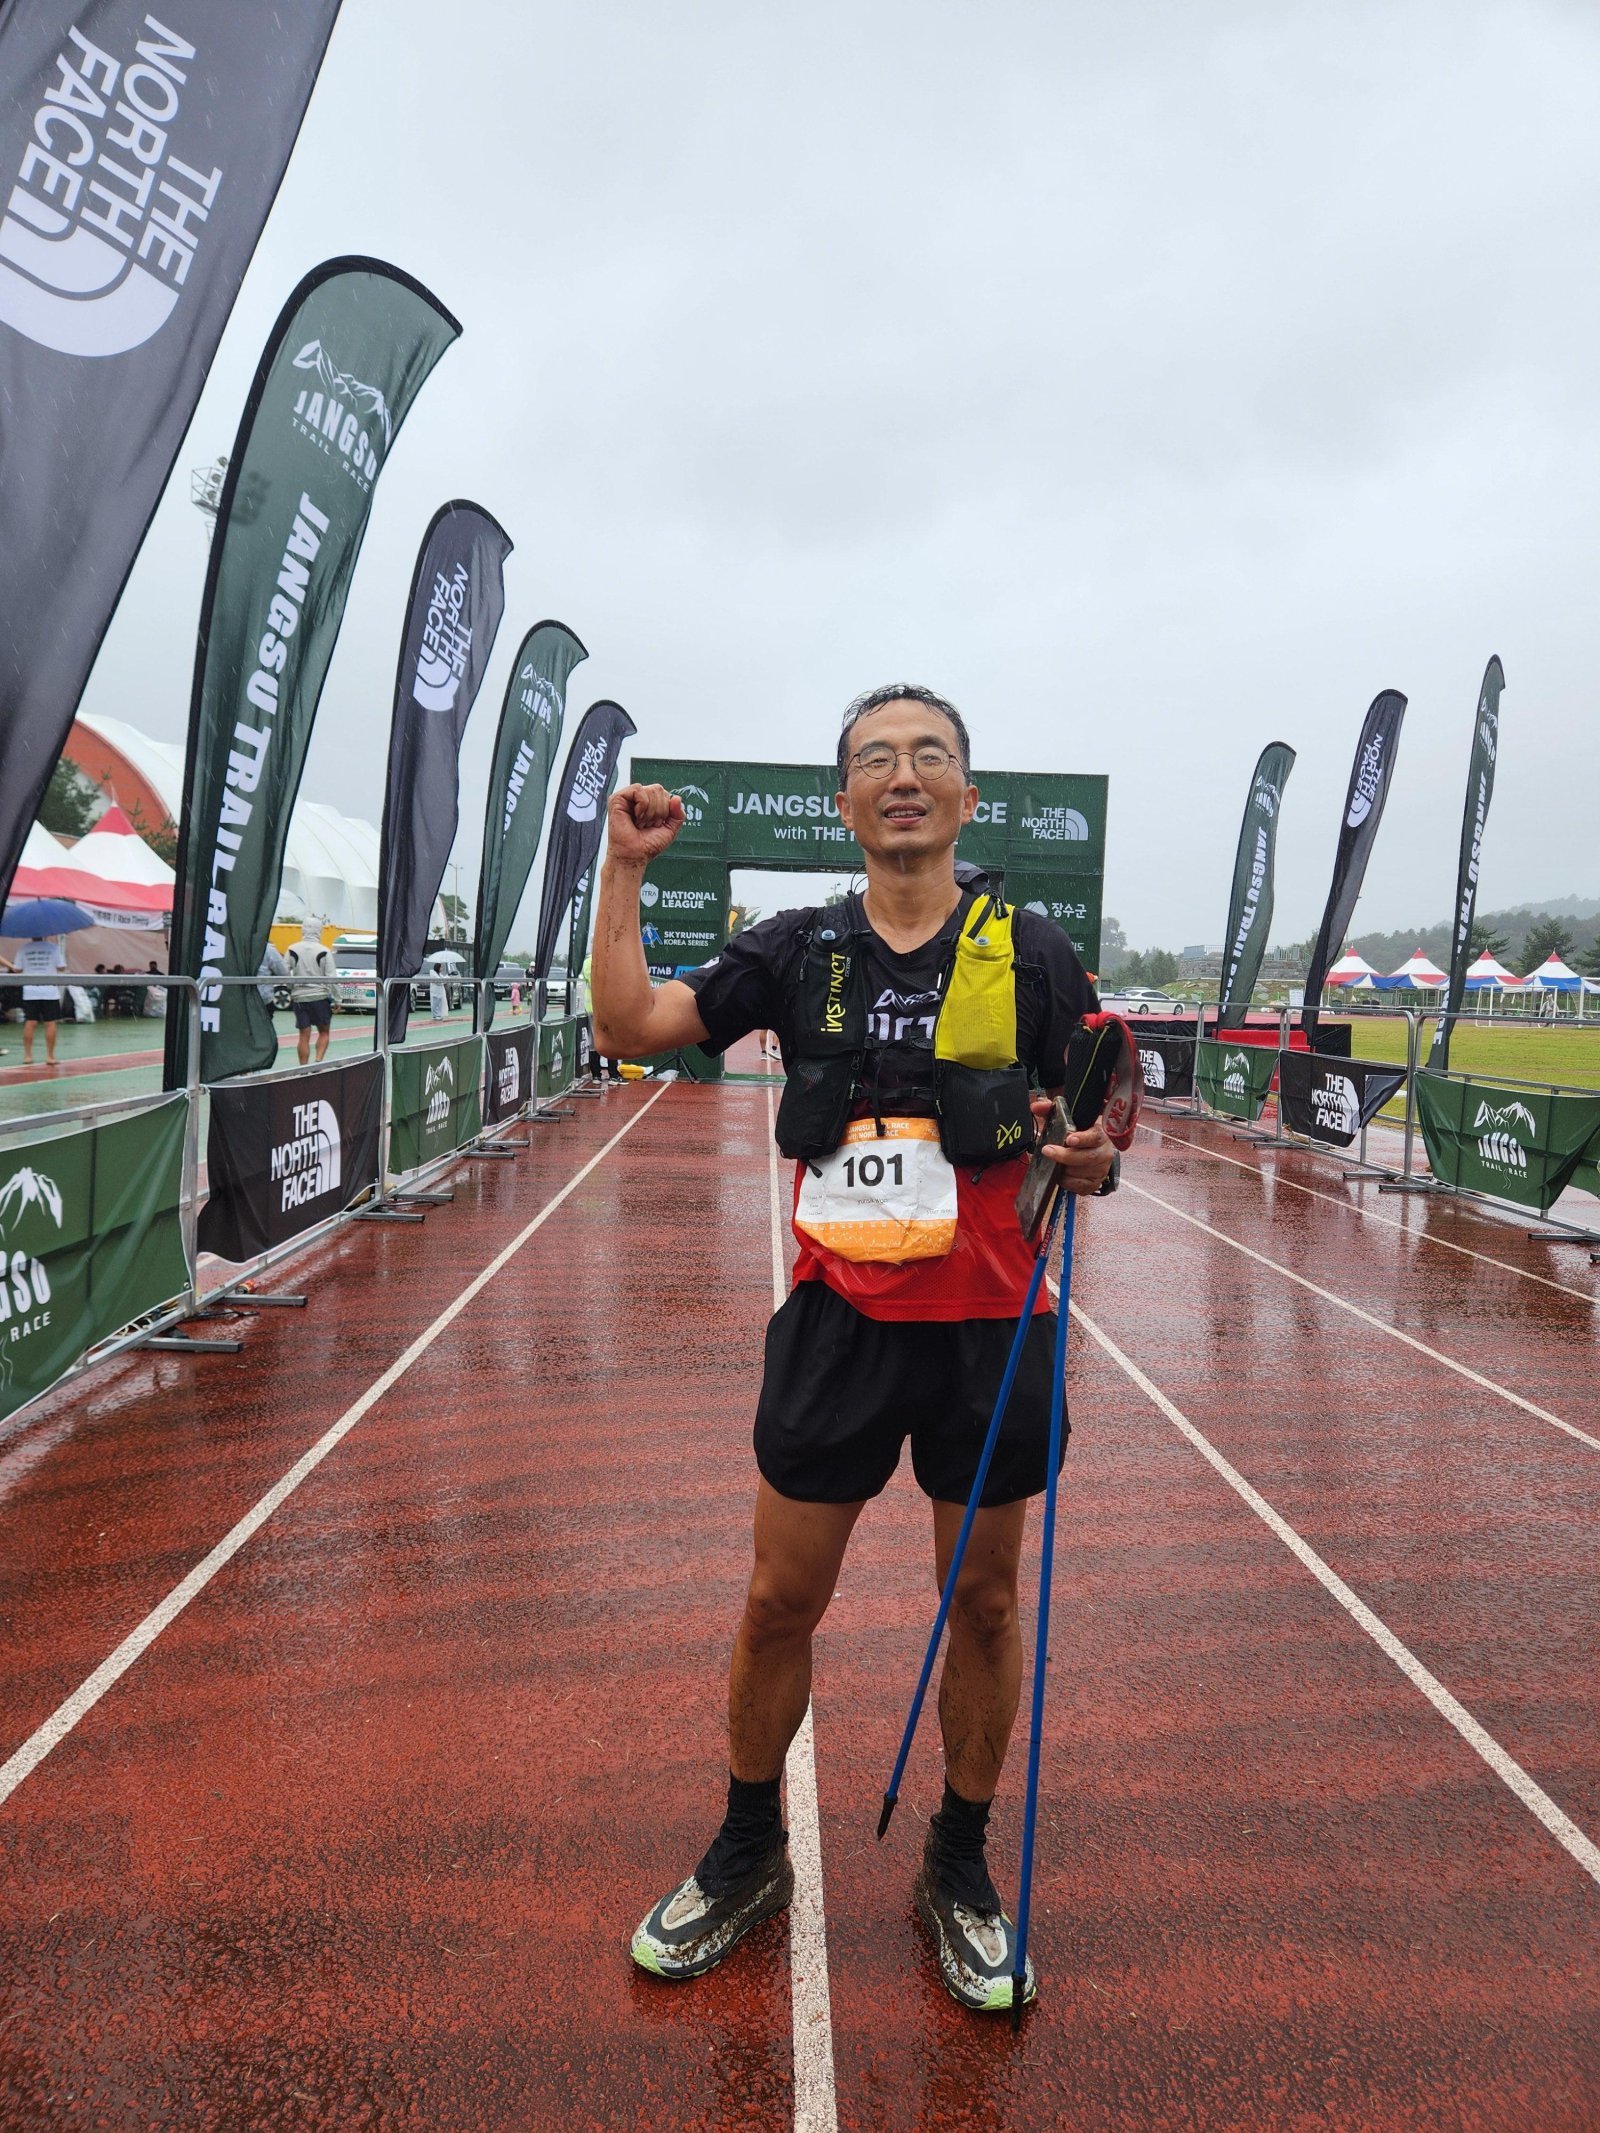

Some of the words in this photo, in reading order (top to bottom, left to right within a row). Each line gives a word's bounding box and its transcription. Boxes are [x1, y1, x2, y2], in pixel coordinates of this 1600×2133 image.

[18, 25, 121, 209] FACE
[80, 14, 196, 249] NORTH
[137, 155, 223, 285] THE
[293, 390, 377, 481] JANGSU
[290, 416, 330, 456] TRAIL
[342, 461, 372, 494] RACE
[246, 491, 330, 715] JANGSU
[423, 571, 451, 651] FACE
[451, 623, 473, 678] THE
[521, 688, 552, 725] JANGS
[576, 740, 596, 788] FACE
[1357, 743, 1373, 791] FACE
[1361, 733, 1383, 799] NORTH
[1366, 768, 1383, 802] THE
[212, 722, 273, 889] TRAIL
[728, 792, 840, 818] JANGSU
[973, 801, 1008, 824] CE
[1022, 817, 1065, 828] NORTH
[1041, 807, 1065, 818] THE
[774, 825, 807, 840] with
[812, 826, 846, 842] THE
[1033, 828, 1064, 840] FACE
[1247, 826, 1267, 902] JANGSU
[662, 890, 717, 901] NATIONAL
[662, 900, 704, 909] LEAGUE
[1051, 902, 1087, 919] 장수군
[200, 887, 227, 1033] RACE
[663, 938, 686, 947] KOREA
[1138, 1050, 1154, 1063] THE
[1311, 1088, 1343, 1112] NORTH
[1325, 1072, 1343, 1094] THE
[292, 1101, 319, 1138] THE
[892, 1122, 909, 1130] RACE
[1315, 1109, 1343, 1131] FACE
[271, 1132, 319, 1181] NORTH
[1478, 1132, 1526, 1168] JANGSU
[843, 1153, 903, 1188] 101
[1481, 1160, 1502, 1172] TRAIL
[1508, 1167, 1528, 1179] RACE
[281, 1166, 318, 1213] FACE
[10, 1311, 51, 1342] RACE
